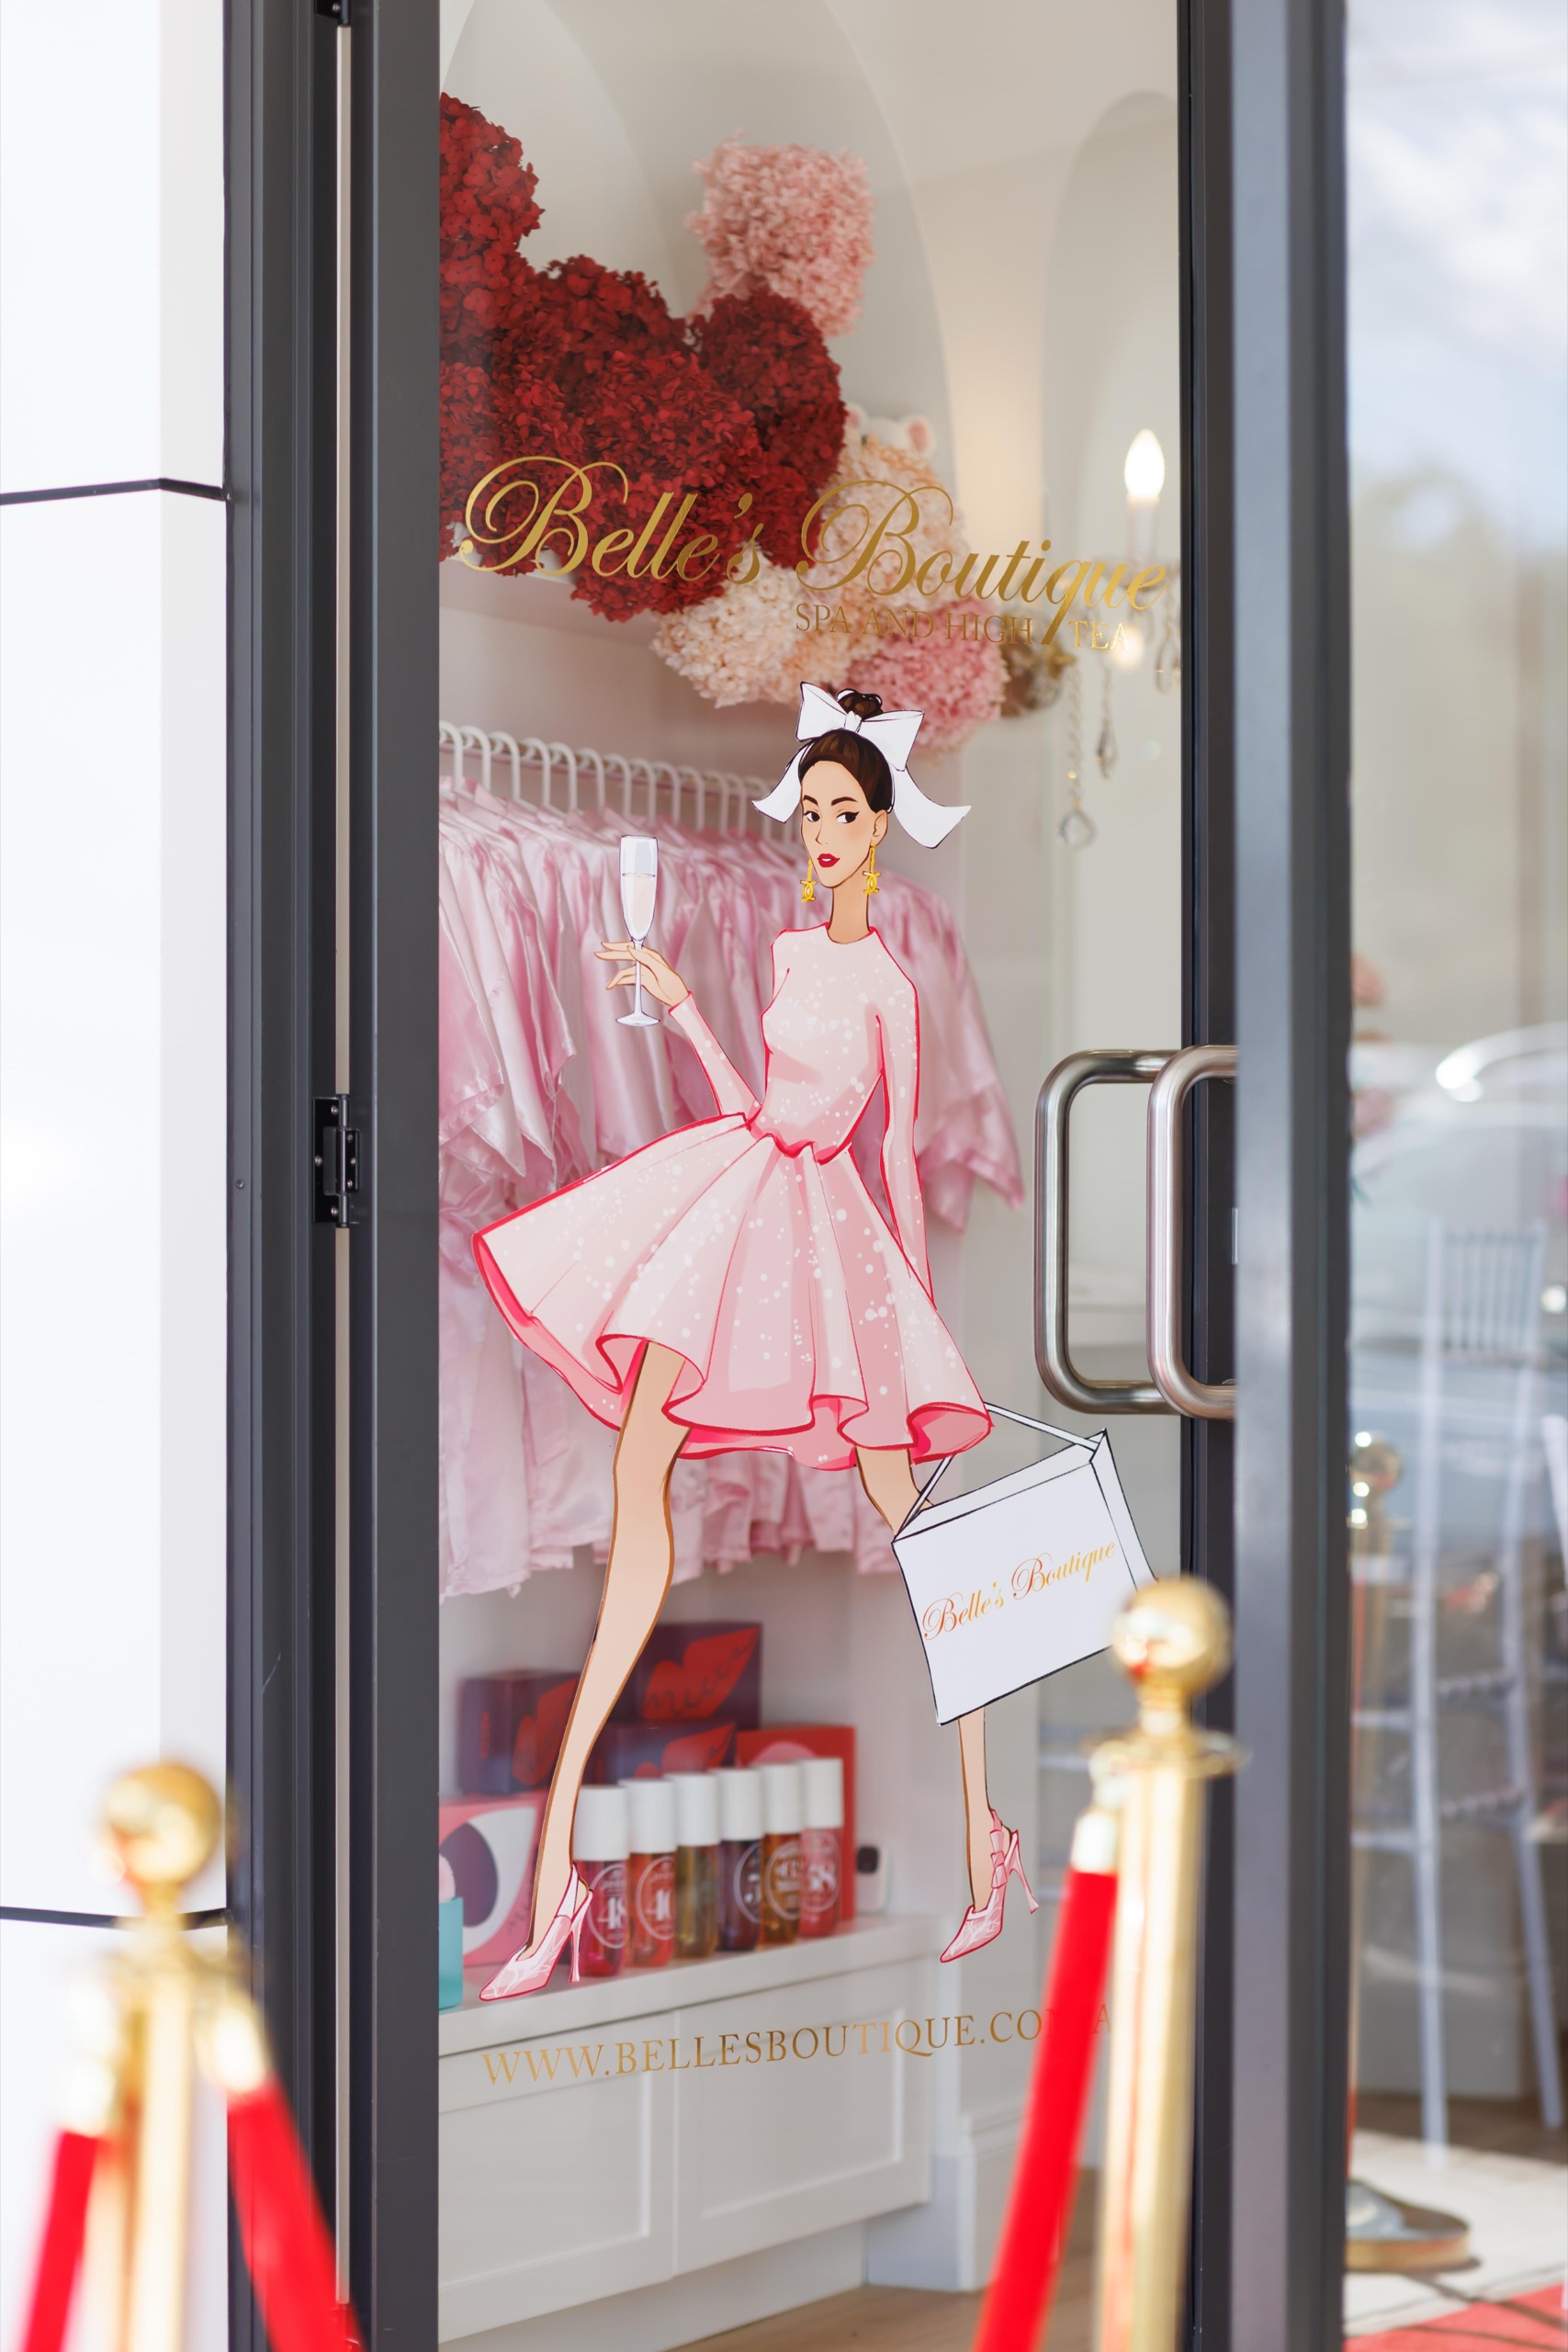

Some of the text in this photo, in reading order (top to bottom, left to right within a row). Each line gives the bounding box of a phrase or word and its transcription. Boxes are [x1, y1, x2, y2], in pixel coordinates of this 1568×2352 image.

[460, 456, 1168, 645] Belle's Boutique
[795, 603, 1132, 650] SPA AND HIGH TEA
[921, 1542, 1116, 1641] Belle's Boutique
